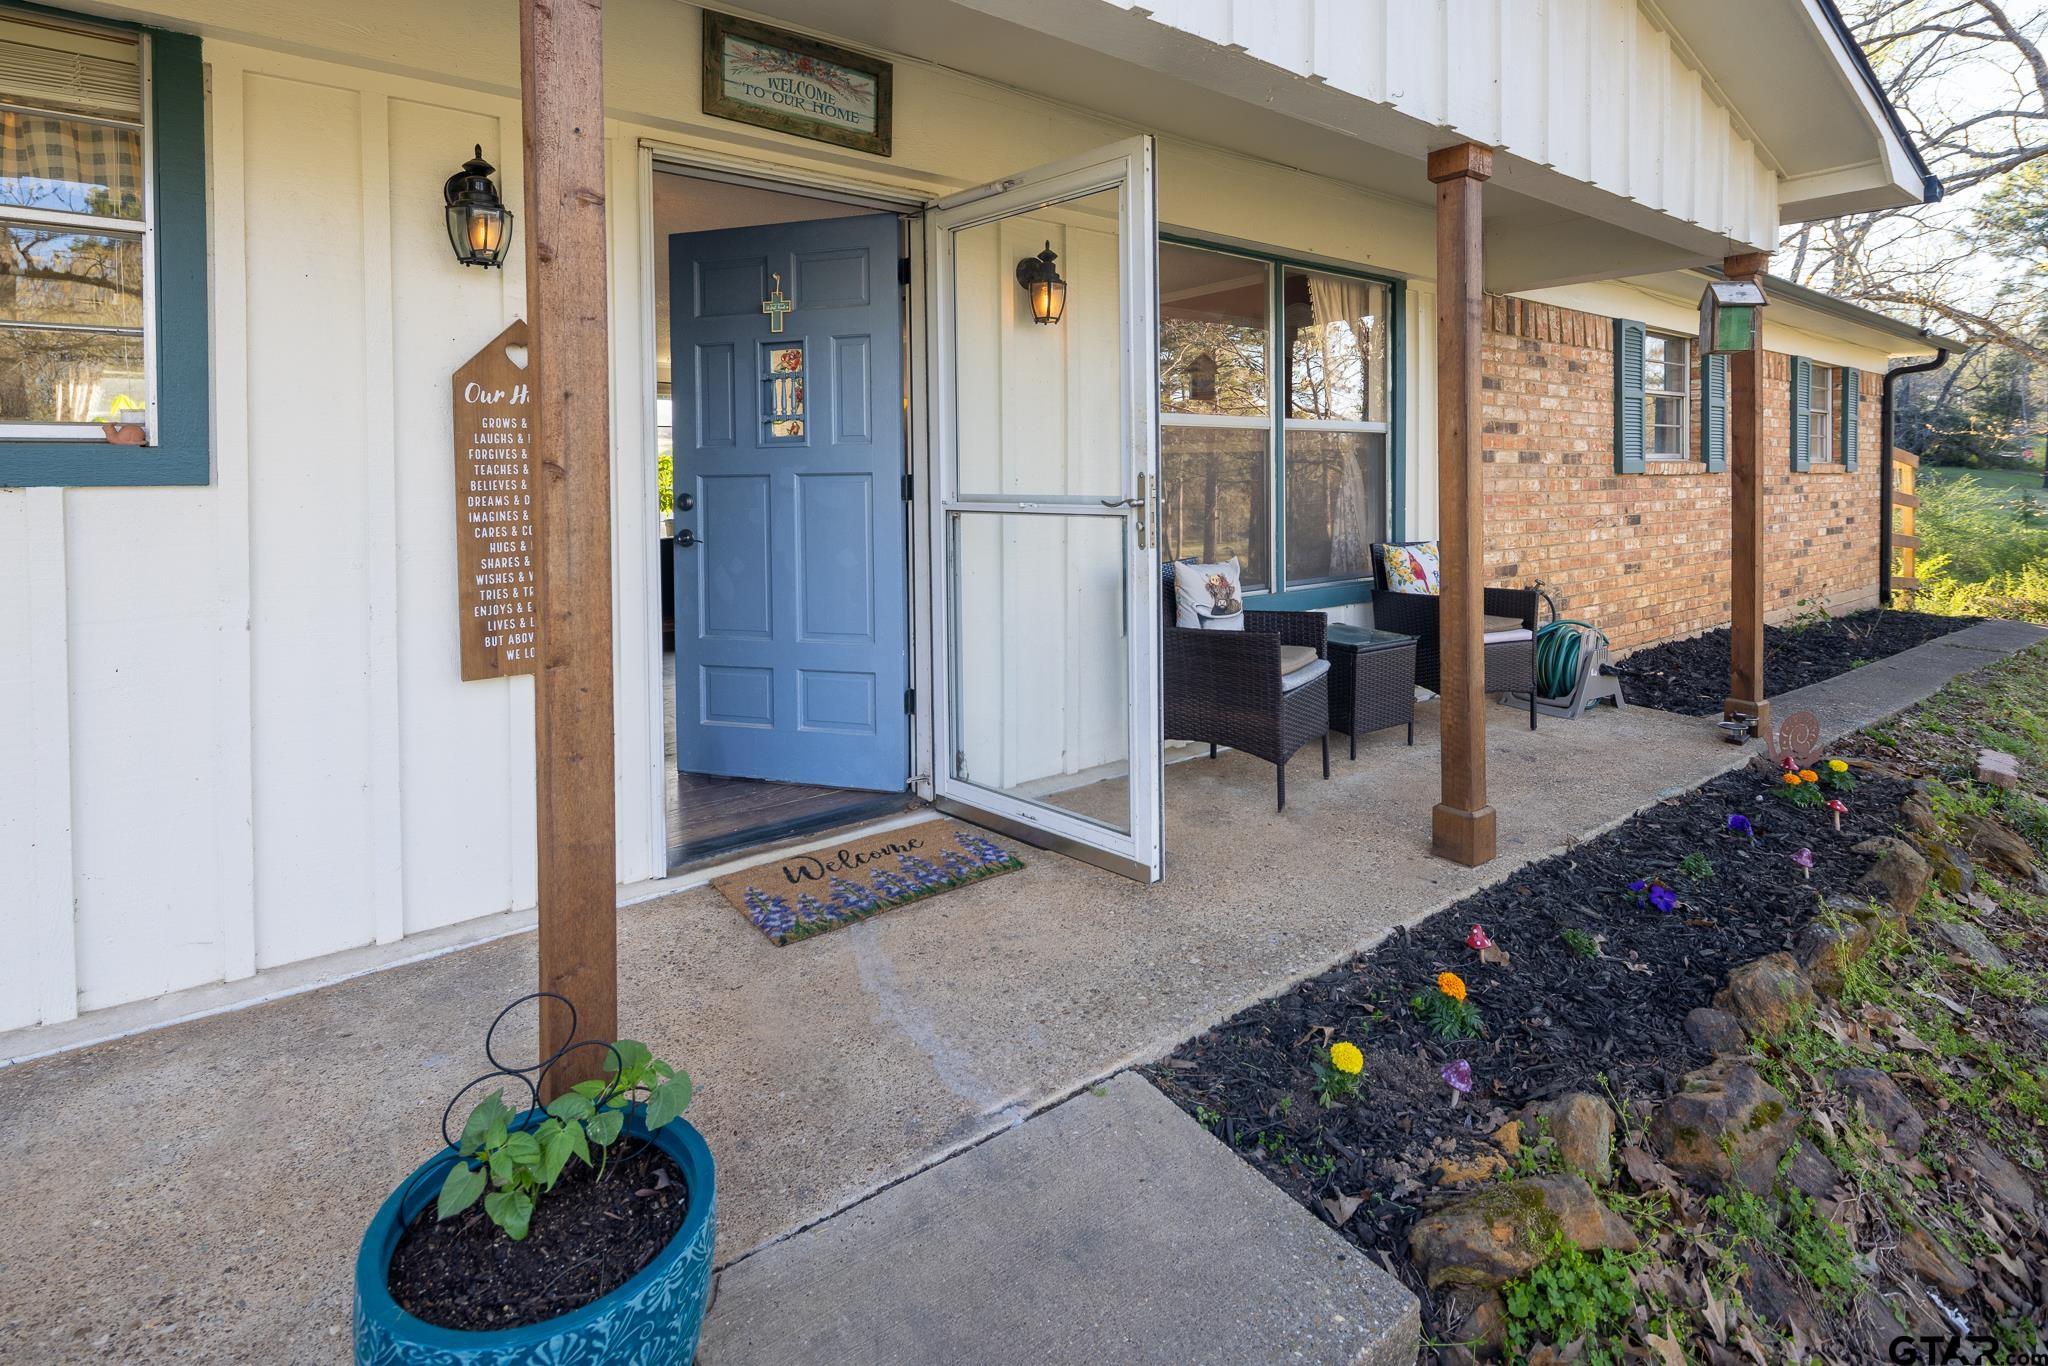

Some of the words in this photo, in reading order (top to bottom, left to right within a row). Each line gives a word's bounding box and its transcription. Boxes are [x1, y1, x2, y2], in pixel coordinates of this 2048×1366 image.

[768, 78, 836, 105] WELCOME
[744, 84, 765, 98] TO
[772, 92, 806, 112] OUR
[812, 101, 860, 124] HOME
[465, 382, 505, 403] Our
[482, 418, 517, 428] GROWS
[522, 418, 528, 428] &
[474, 433, 513, 444] LAUGHS
[518, 434, 523, 444] &
[469, 449, 517, 460] FORGIVES
[522, 449, 528, 459] &
[474, 464, 518, 475] TEACHES
[523, 464, 529, 474] &
[471, 480, 517, 491] BELIEVES
[521, 480, 527, 489] &
[468, 496, 509, 507] DREAMS
[514, 495, 520, 505] &
[469, 511, 518, 522] IMAGINES
[522, 510, 529, 520] &
[474, 526, 507, 538] CARES
[511, 526, 518, 536] &
[490, 542, 516, 553] HUGS
[520, 541, 526, 552] &
[481, 557, 520, 569] SHARES
[524, 556, 530, 566] &
[476, 572, 514, 585] WISHES
[518, 572, 525, 582] &
[480, 588, 508, 600] TRIES
[513, 588, 519, 598] &
[474, 603, 512, 617] ENJOYS
[517, 602, 523, 613] &
[488, 619, 515, 631] LIVES
[520, 618, 526, 628] &
[485, 636, 503, 648] BUT
[507, 650, 520, 661] WE
[783, 838, 924, 884] Welcome
